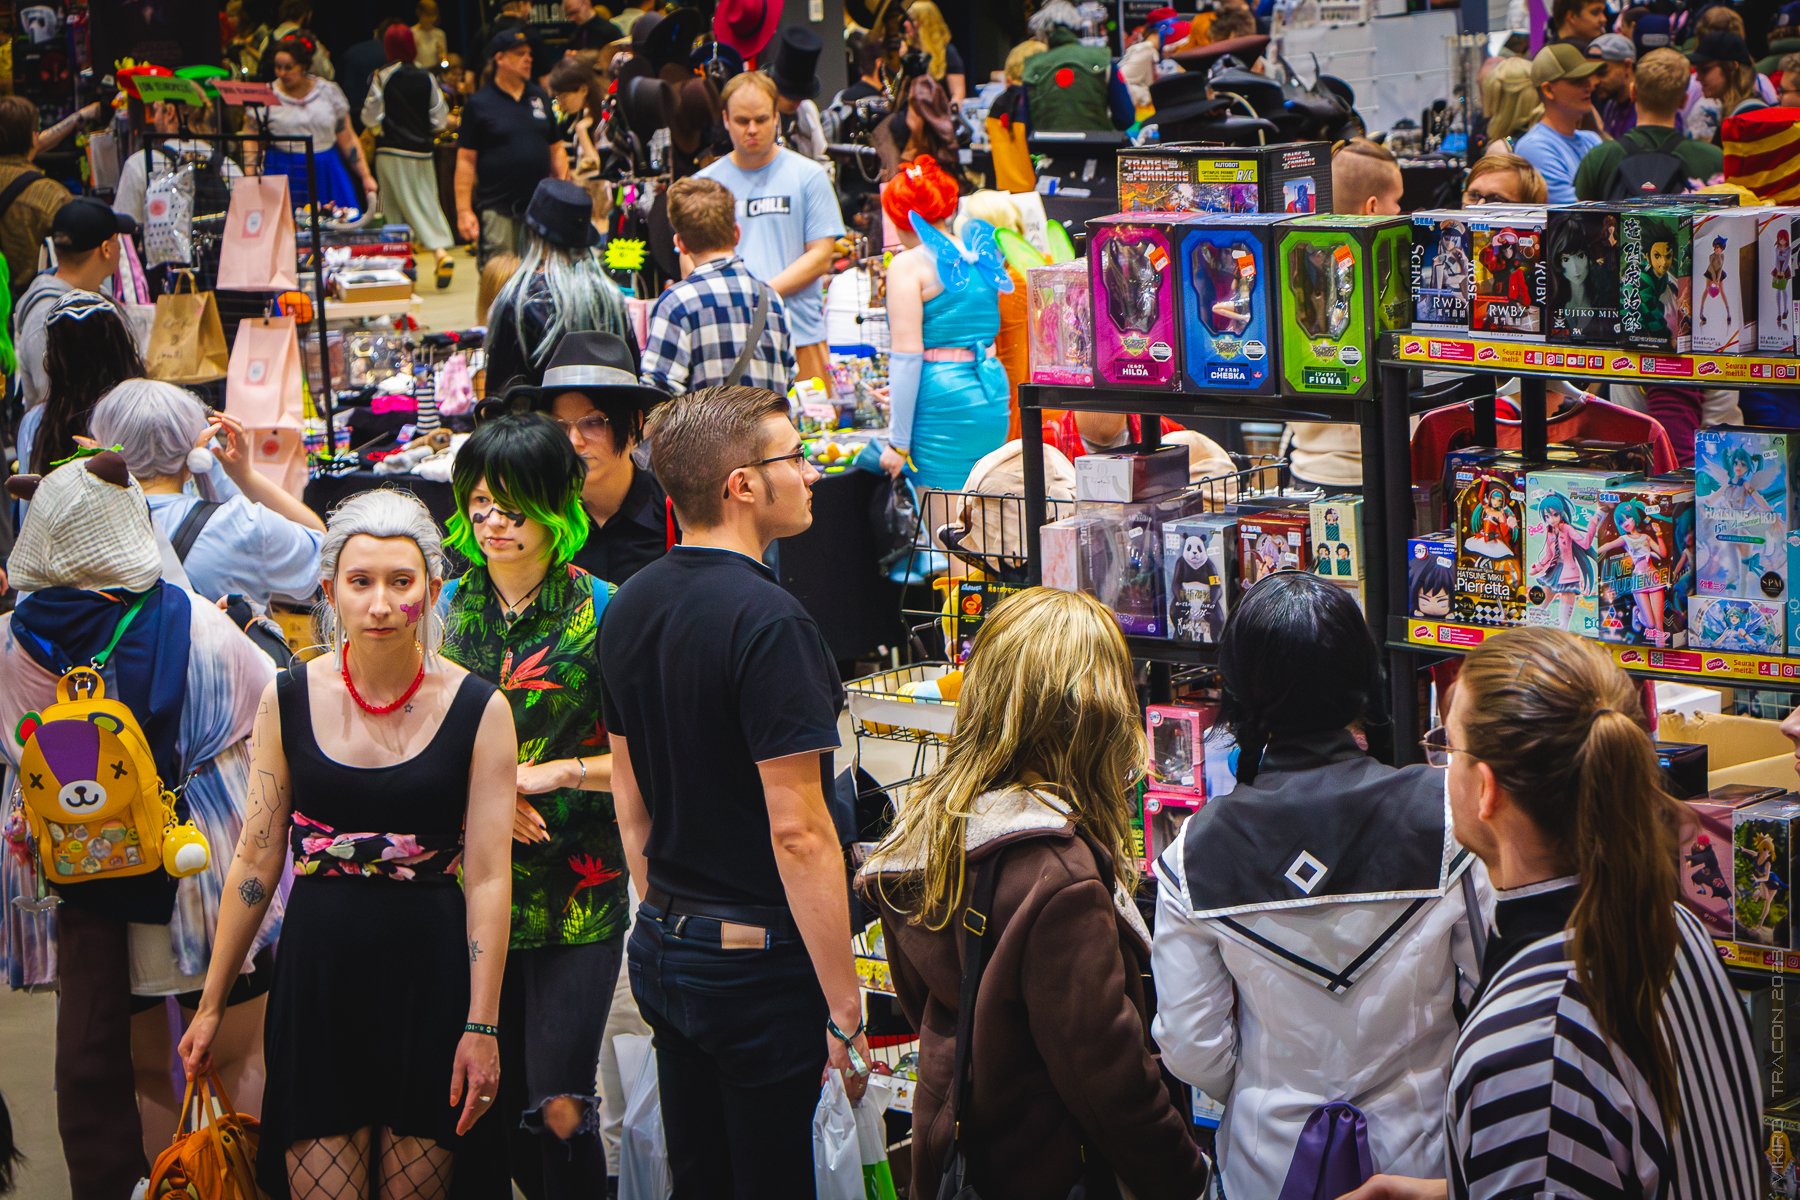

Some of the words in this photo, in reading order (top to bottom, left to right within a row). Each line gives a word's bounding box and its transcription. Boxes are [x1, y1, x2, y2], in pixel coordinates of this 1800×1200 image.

[1236, 169, 1254, 182] R/C
[748, 197, 790, 216] CHILL.
[1411, 244, 1425, 302] SCHNEE
[1488, 304, 1527, 318] RWBY
[1557, 308, 1595, 317] FUJIKO
[1122, 368, 1149, 376] HILDA
[1725, 362, 1747, 370] Seuraa
[1210, 372, 1246, 380] CHESKA
[1308, 376, 1342, 385] FIONA
[1599, 493, 1620, 502] SEGA
[1602, 556, 1633, 580] LIVE
[1457, 570, 1487, 581] HATSUNE
[1487, 573, 1505, 583] MIKU
[1608, 568, 1670, 595] AUDIENCE
[1457, 577, 1511, 597] Pierretta
[1733, 659, 1755, 668] Seuraa
